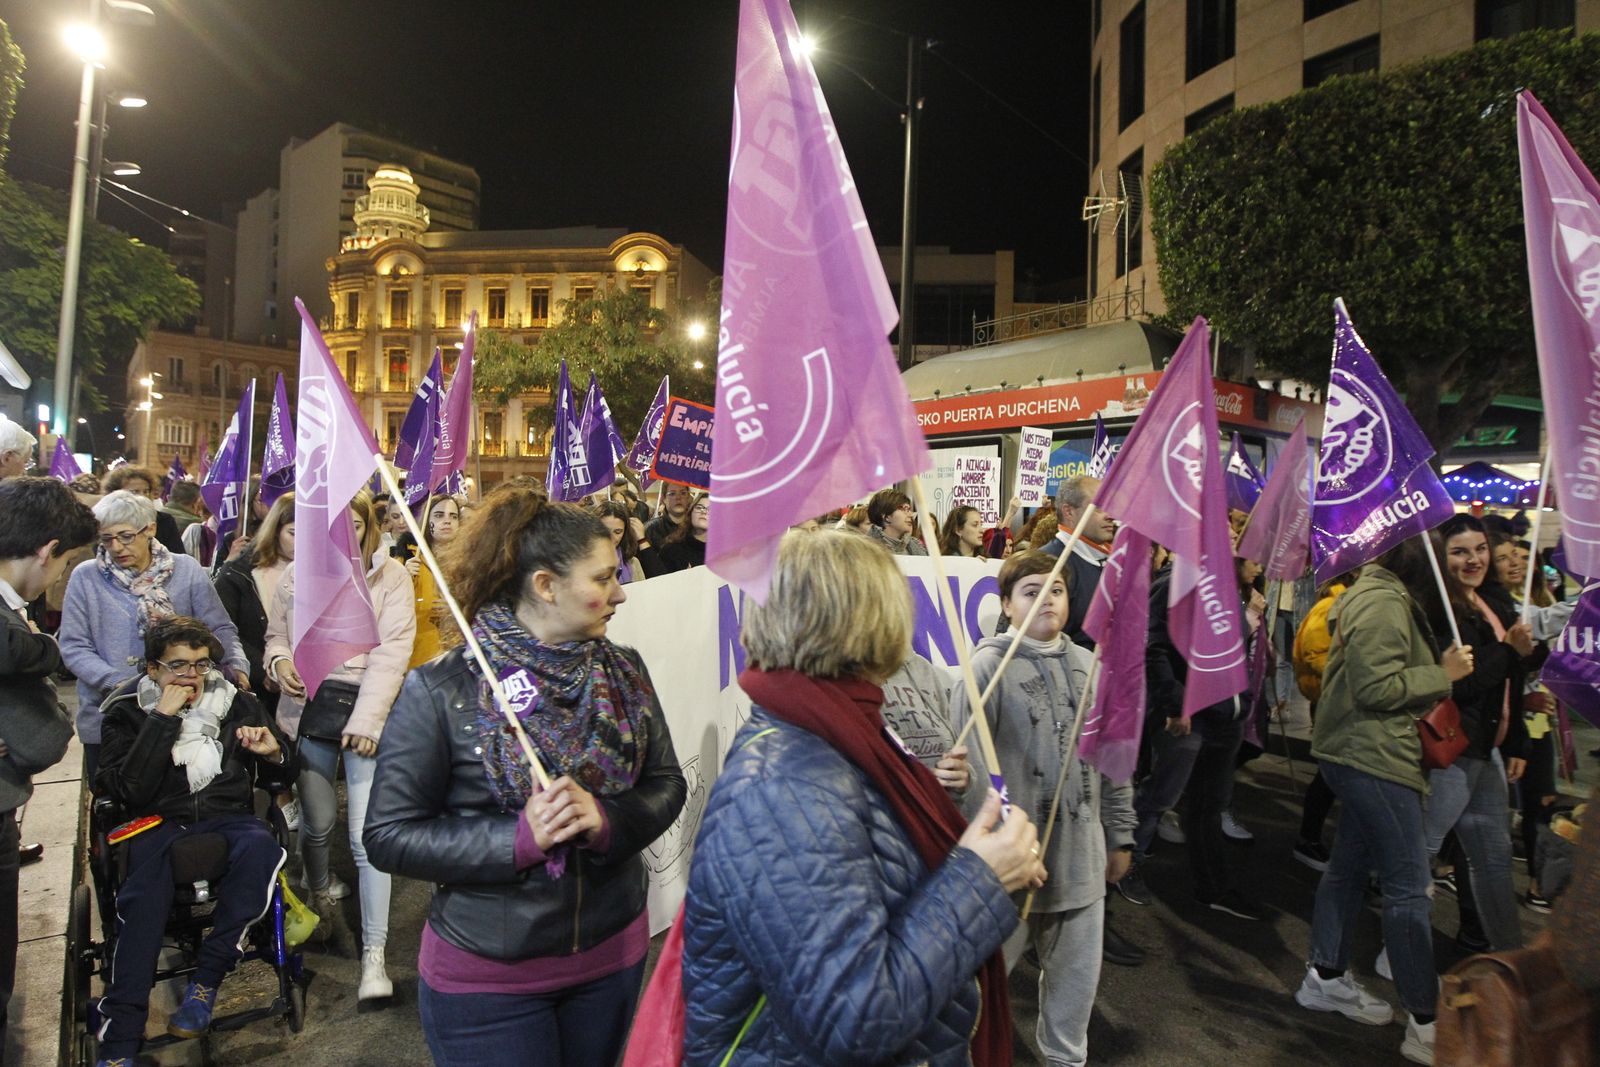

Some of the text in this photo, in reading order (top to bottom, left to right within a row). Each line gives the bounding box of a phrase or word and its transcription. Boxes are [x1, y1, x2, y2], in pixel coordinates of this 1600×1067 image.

[915, 396, 1081, 426] SKO PUERTA PURCHENA
[695, 441, 710, 454] EL
[956, 458, 962, 470] A
[960, 472, 986, 485] HOMBRE
[953, 485, 990, 498] CONSIENTO
